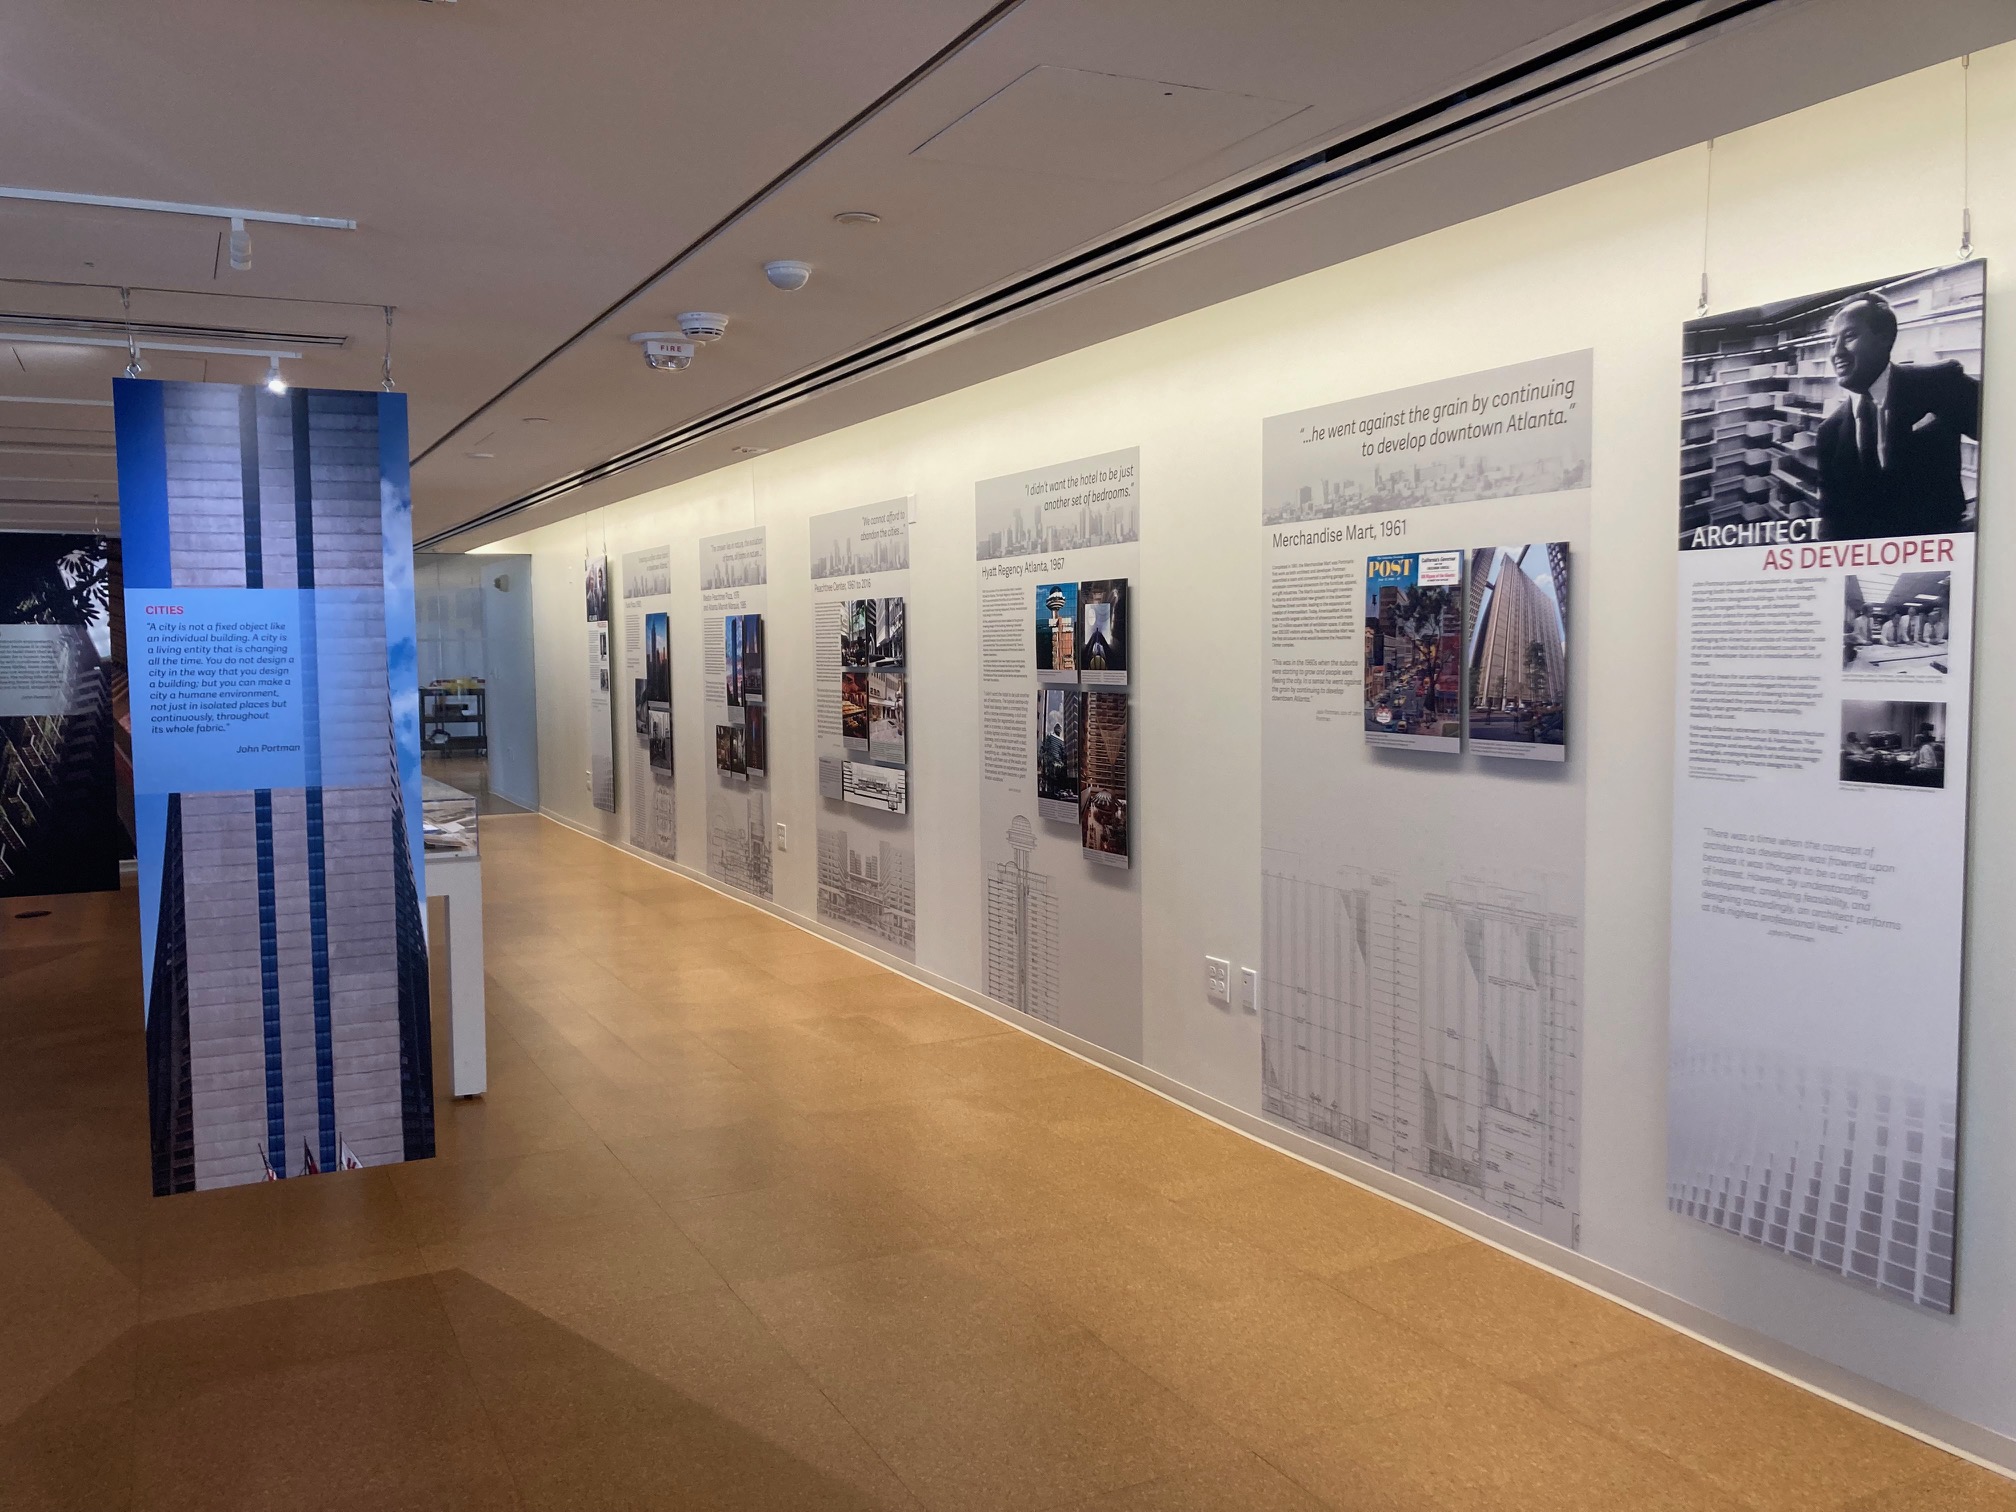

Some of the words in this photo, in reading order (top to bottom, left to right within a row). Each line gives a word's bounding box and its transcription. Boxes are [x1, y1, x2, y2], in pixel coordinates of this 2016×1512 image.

[1328, 420, 1355, 439] went
[1359, 412, 1405, 435] against
[1409, 406, 1429, 423] the
[1433, 398, 1467, 423] grain
[1472, 394, 1488, 413] by
[1492, 379, 1575, 408] continuing
[1362, 442, 1374, 457] to
[1377, 432, 1426, 454] develop
[1429, 419, 1502, 445] downtown
[1050, 479, 1066, 492] want
[1067, 476, 1078, 488] the
[1080, 470, 1098, 486] hotel
[1100, 471, 1107, 482] to
[1109, 467, 1118, 480] be
[1118, 465, 1133, 482] just
[1044, 497, 1070, 510] another
[1072, 496, 1081, 506] set
[1083, 491, 1092, 505] of
[1273, 528, 1342, 548] Merchandise
[1346, 522, 1377, 541] Mart,
[1380, 520, 1407, 537] 1961
[1691, 518, 1822, 548] ARCHITECT
[1763, 549, 1793, 571] AS
[1800, 539, 1954, 569] DEVELOPER
[982, 566, 996, 579] Hyatt
[998, 563, 1023, 578] Regency
[1025, 560, 1048, 573] Atlanta,
[1050, 558, 1064, 570] 1967
[1369, 559, 1413, 578] POST
[146, 606, 183, 614] CITIES
[159, 623, 176, 632] city
[215, 623, 237, 632] fixed
[240, 622, 268, 632] object
[271, 622, 285, 630] like
[162, 634, 208, 642] individual
[211, 634, 249, 644] building.
[261, 634, 277, 643] city
[156, 646, 181, 655] living
[184, 646, 210, 654] entity
[246, 646, 288, 654] changing
[181, 657, 202, 665] time.
[257, 656, 286, 665] design
[149, 669, 166, 678] city
[198, 670, 216, 678] way
[240, 669, 257, 677] you
[259, 668, 289, 676] design
[202, 679, 217, 687] but
[220, 680, 236, 688] you
[150, 692, 167, 700] city
[179, 691, 217, 699] humane
[220, 690, 279, 698] environment,
[151, 703, 166, 711] not
[168, 702, 186, 712] just
[189, 702, 197, 710] in
[200, 701, 237, 709] isolated
[240, 701, 269, 710] places
[151, 713, 214, 723] continuously,
[217, 712, 269, 722] throughout
[237, 745, 259, 753] John
[262, 744, 300, 752] Portman
